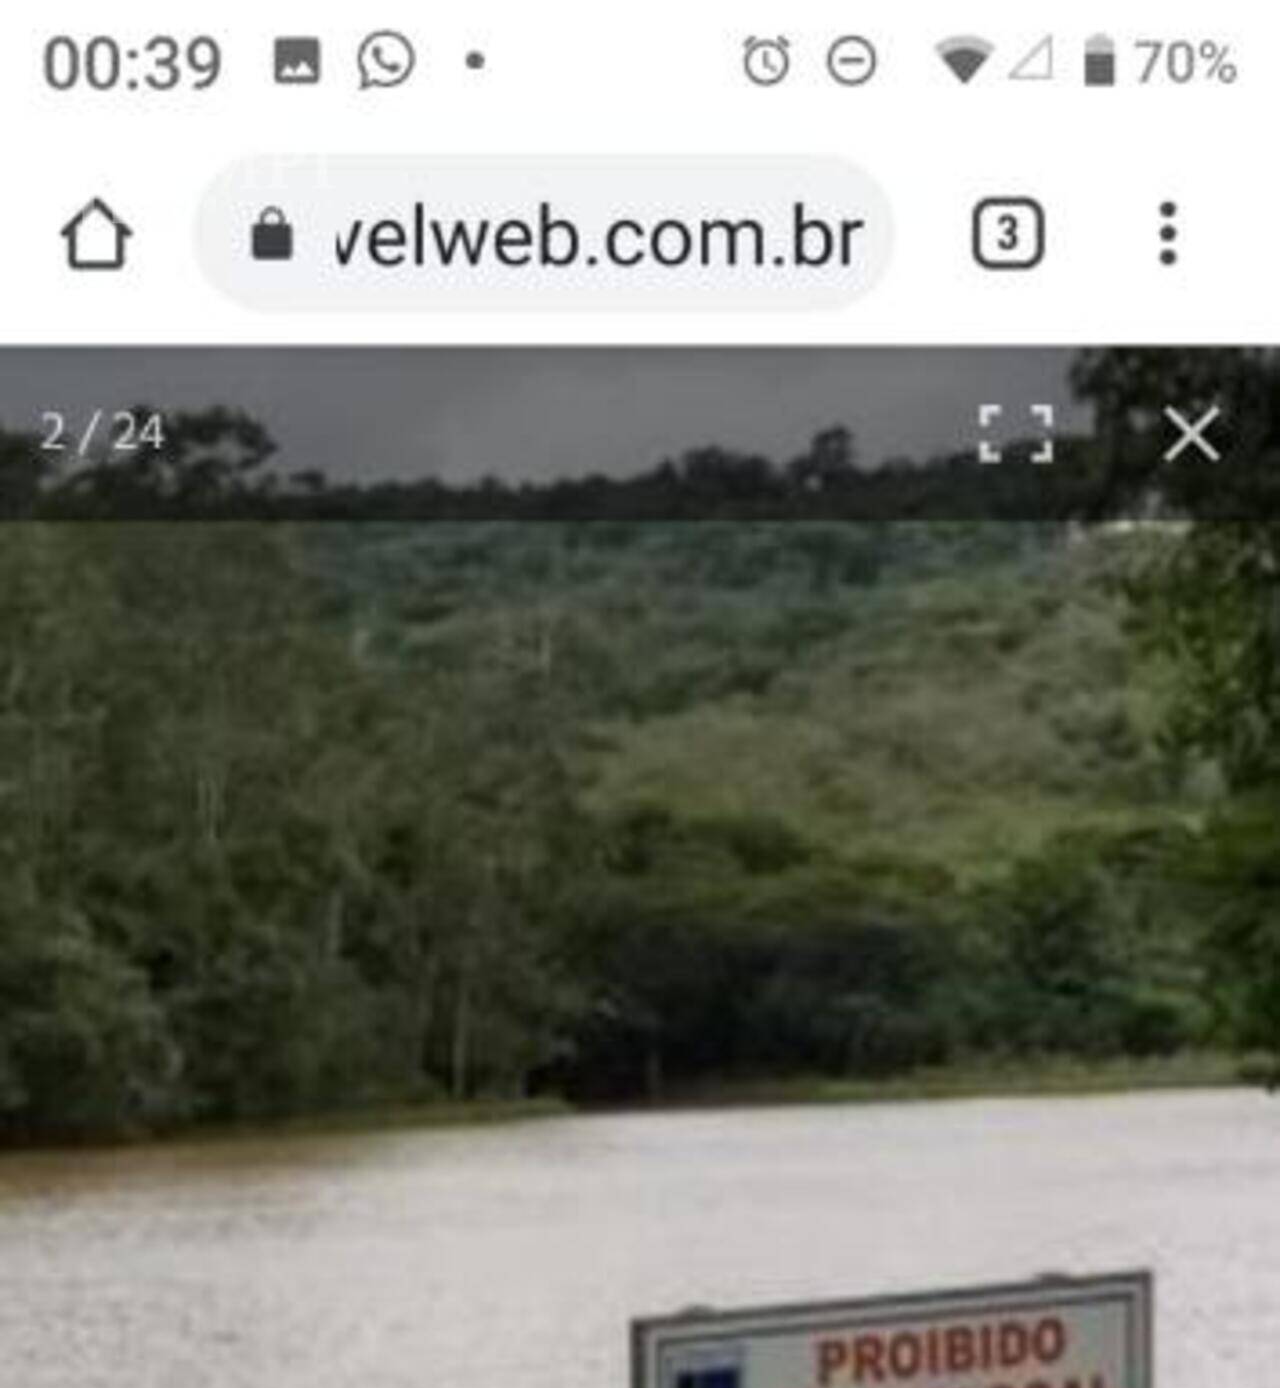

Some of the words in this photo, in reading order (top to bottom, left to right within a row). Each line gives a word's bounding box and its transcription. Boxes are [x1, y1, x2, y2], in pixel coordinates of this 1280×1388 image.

[42, 35, 222, 92] 00:39
[1134, 40, 1238, 86] 70%
[335, 201, 864, 267] velweb.com.br
[997, 213, 1020, 251] 3
[41, 410, 65, 450] 2
[113, 410, 165, 450] 24
[816, 1317, 1066, 1387] PROIBIDO
